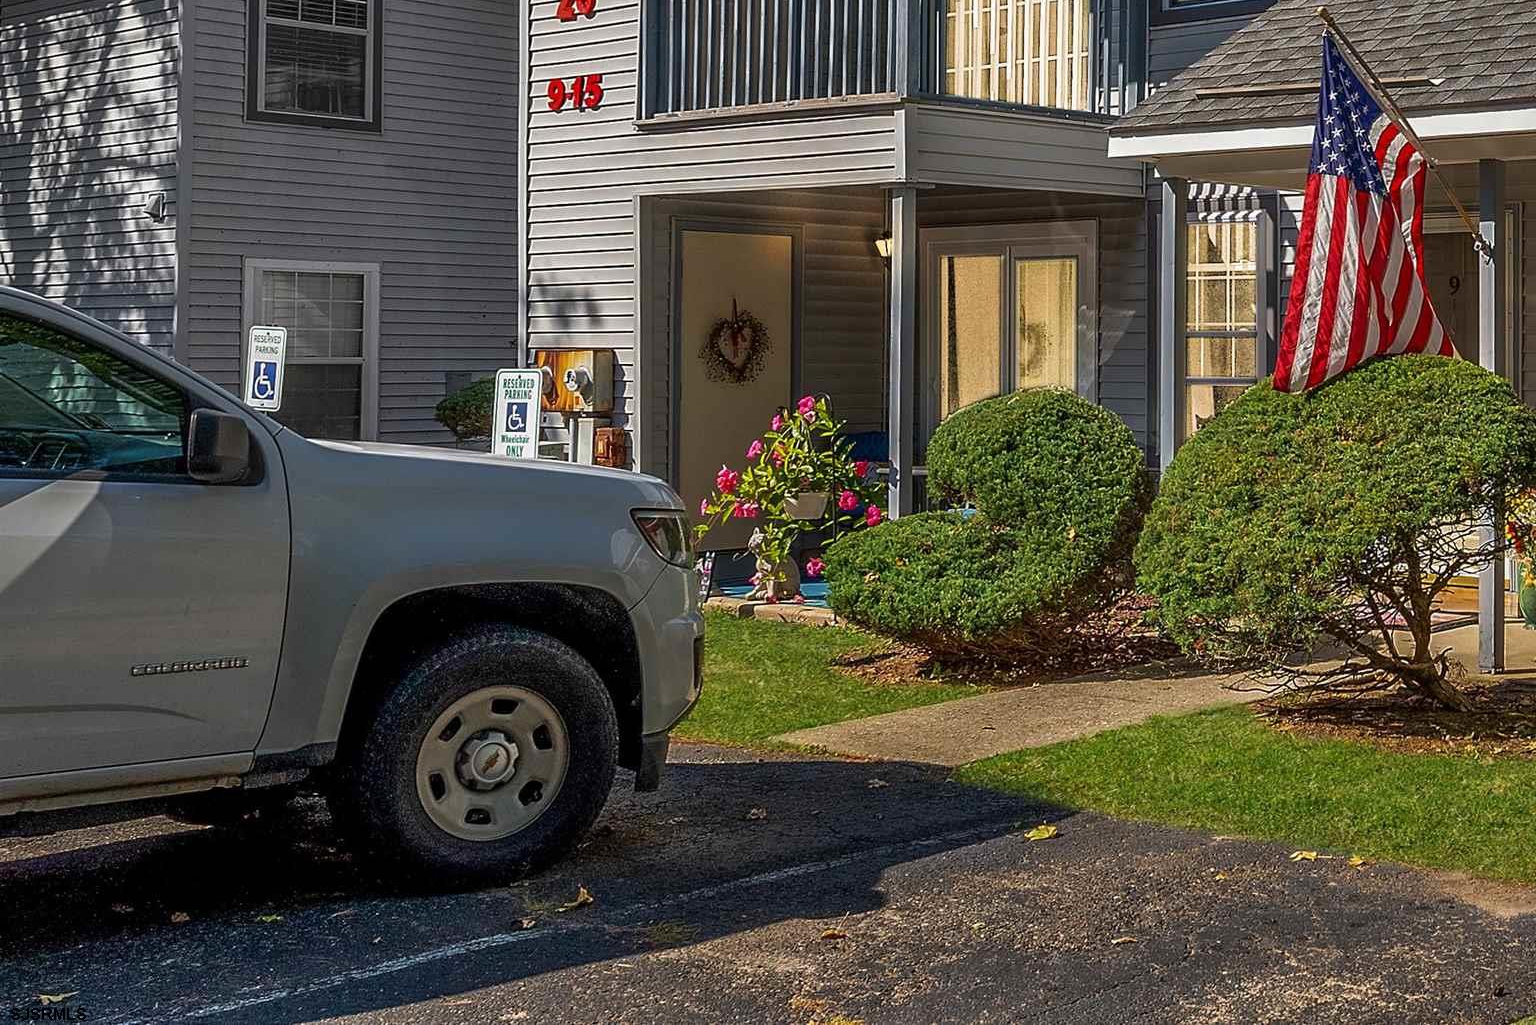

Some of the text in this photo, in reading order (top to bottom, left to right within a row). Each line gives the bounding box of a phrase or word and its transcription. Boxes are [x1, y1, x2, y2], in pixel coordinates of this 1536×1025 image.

[548, 74, 604, 112] 9-15
[1448, 276, 1460, 295] 9
[254, 335, 281, 344] RESERVED
[255, 346, 279, 355] PARKING
[503, 378, 535, 389] RESERVED
[504, 389, 532, 400] PARKING
[501, 434, 529, 444] Wheelchair
[506, 445, 524, 457] ONLY
